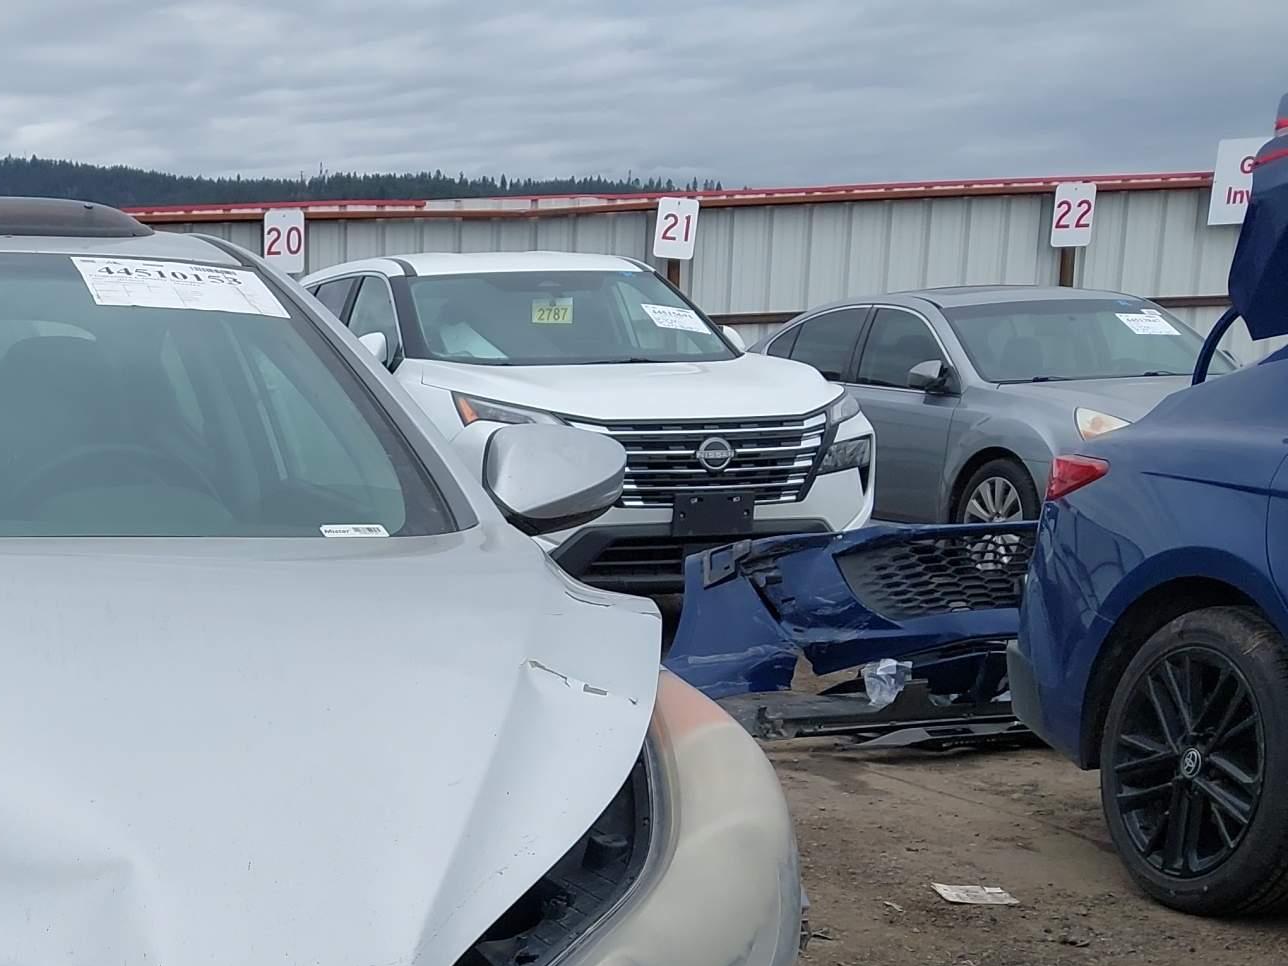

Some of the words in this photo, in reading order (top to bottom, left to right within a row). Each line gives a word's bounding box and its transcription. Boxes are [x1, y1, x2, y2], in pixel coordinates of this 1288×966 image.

[662, 213, 692, 242] 21
[1055, 199, 1092, 229] 22
[266, 226, 302, 256] 20
[97, 266, 243, 287] 44510153
[537, 307, 569, 321] 2787
